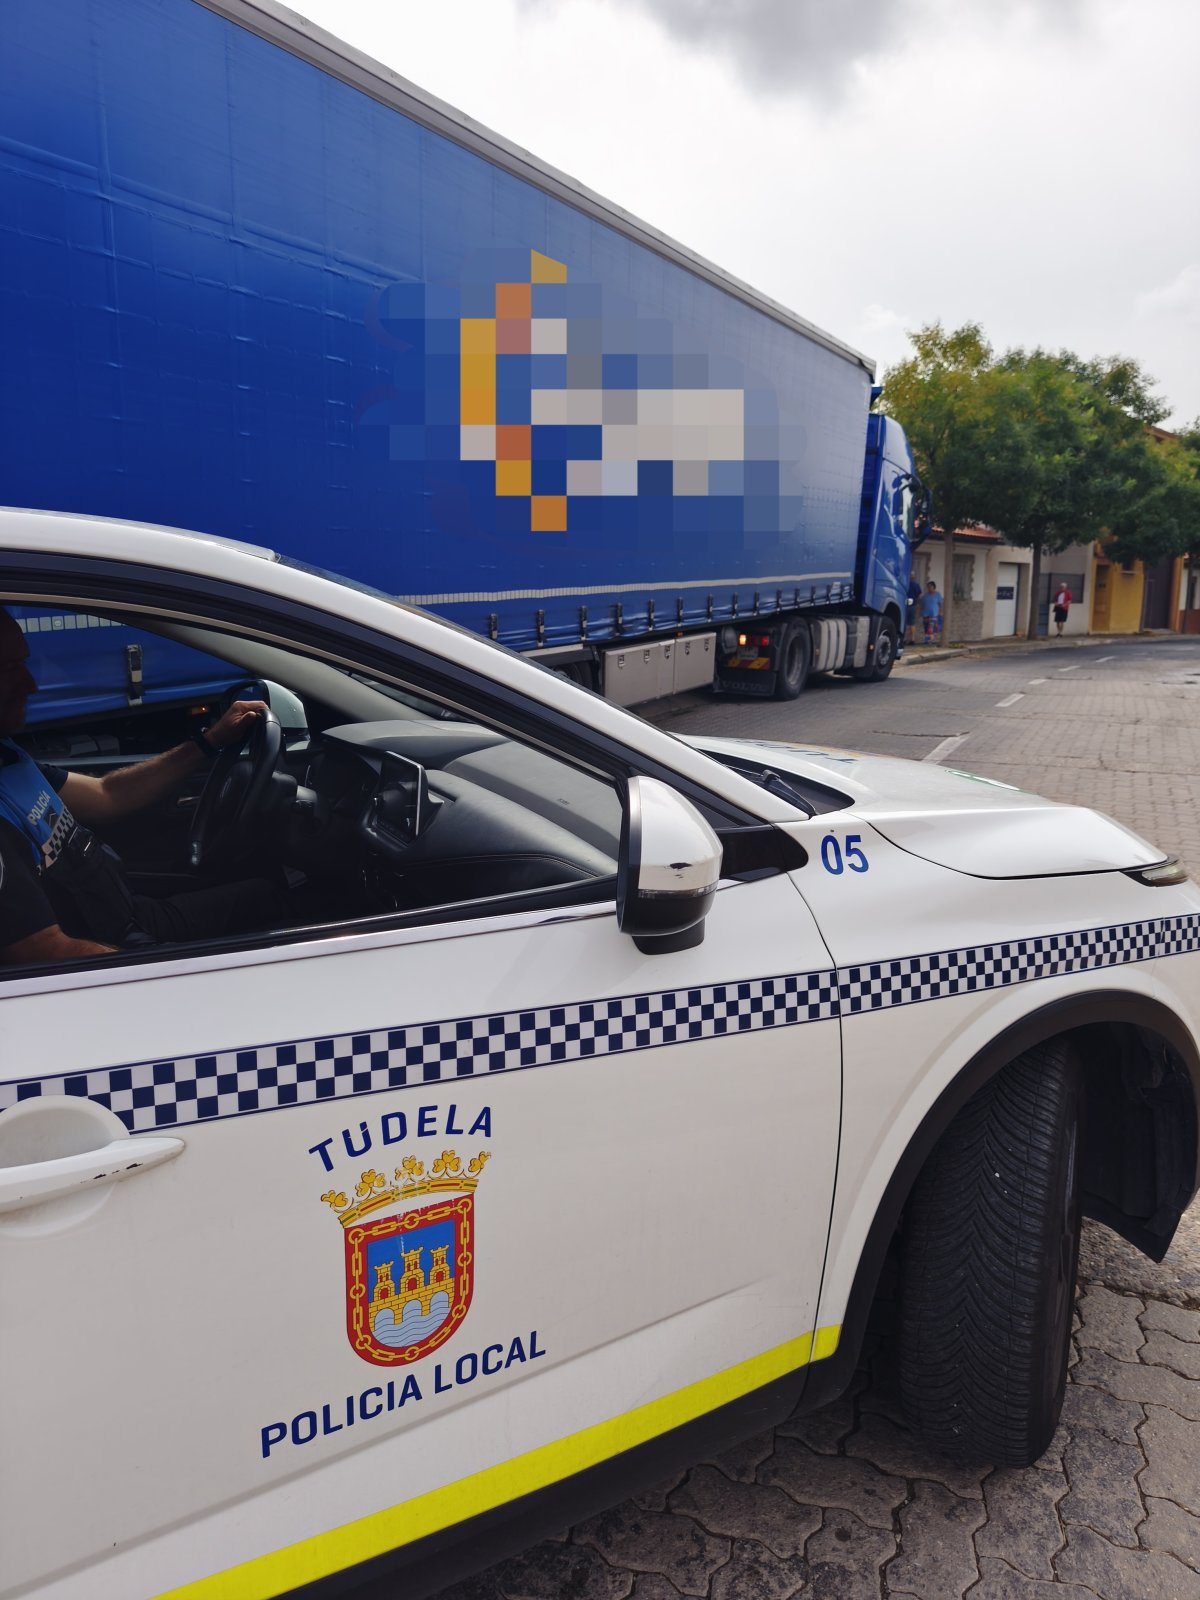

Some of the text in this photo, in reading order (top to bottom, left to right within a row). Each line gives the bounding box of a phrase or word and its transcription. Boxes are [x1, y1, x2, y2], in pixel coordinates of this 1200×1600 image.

[820, 834, 869, 876] 05
[308, 1104, 492, 1172] TUDELA
[260, 1330, 546, 1458] POLICIA LOCAL
